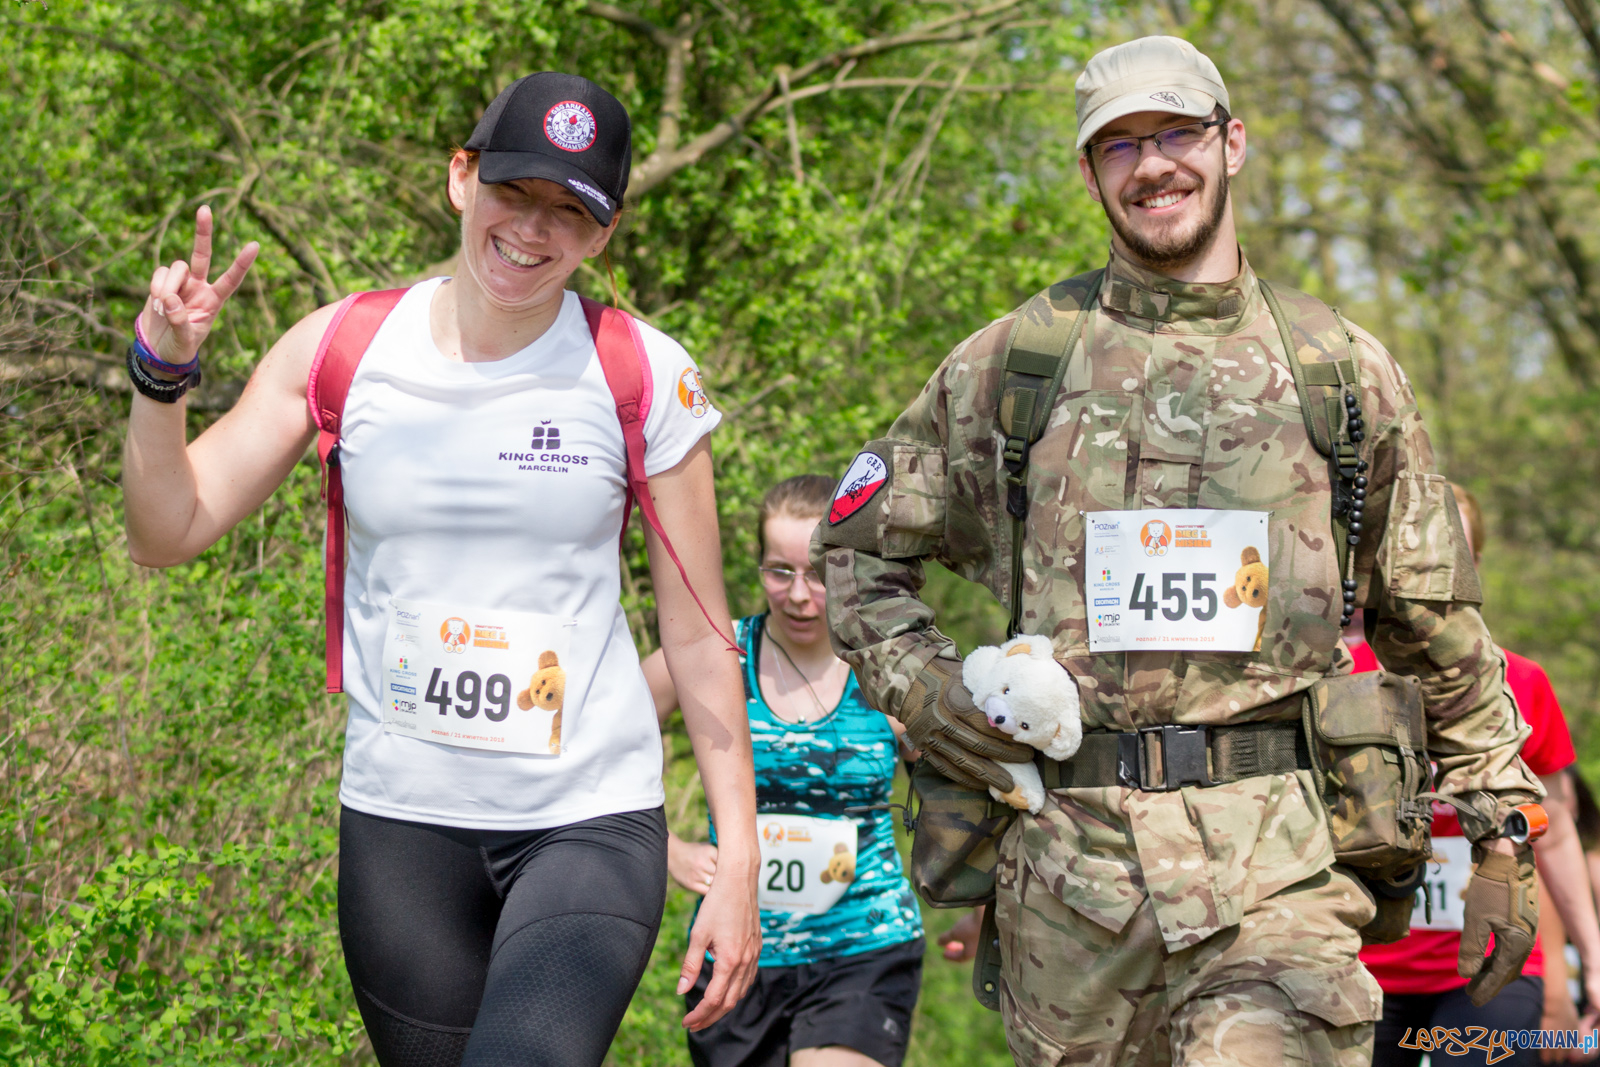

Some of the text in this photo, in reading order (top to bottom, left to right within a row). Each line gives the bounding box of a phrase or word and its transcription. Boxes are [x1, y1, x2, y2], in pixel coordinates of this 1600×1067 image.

[565, 103, 596, 130] ARMAMENT
[553, 138, 590, 150] ARMAMENT
[498, 452, 589, 466] KING CROSS
[518, 464, 569, 473] MARCELIN
[1128, 572, 1218, 622] 455
[1104, 613, 1120, 623] mjp
[424, 667, 512, 723] 499
[400, 700, 417, 711] mjp
[766, 858, 805, 893] 20
